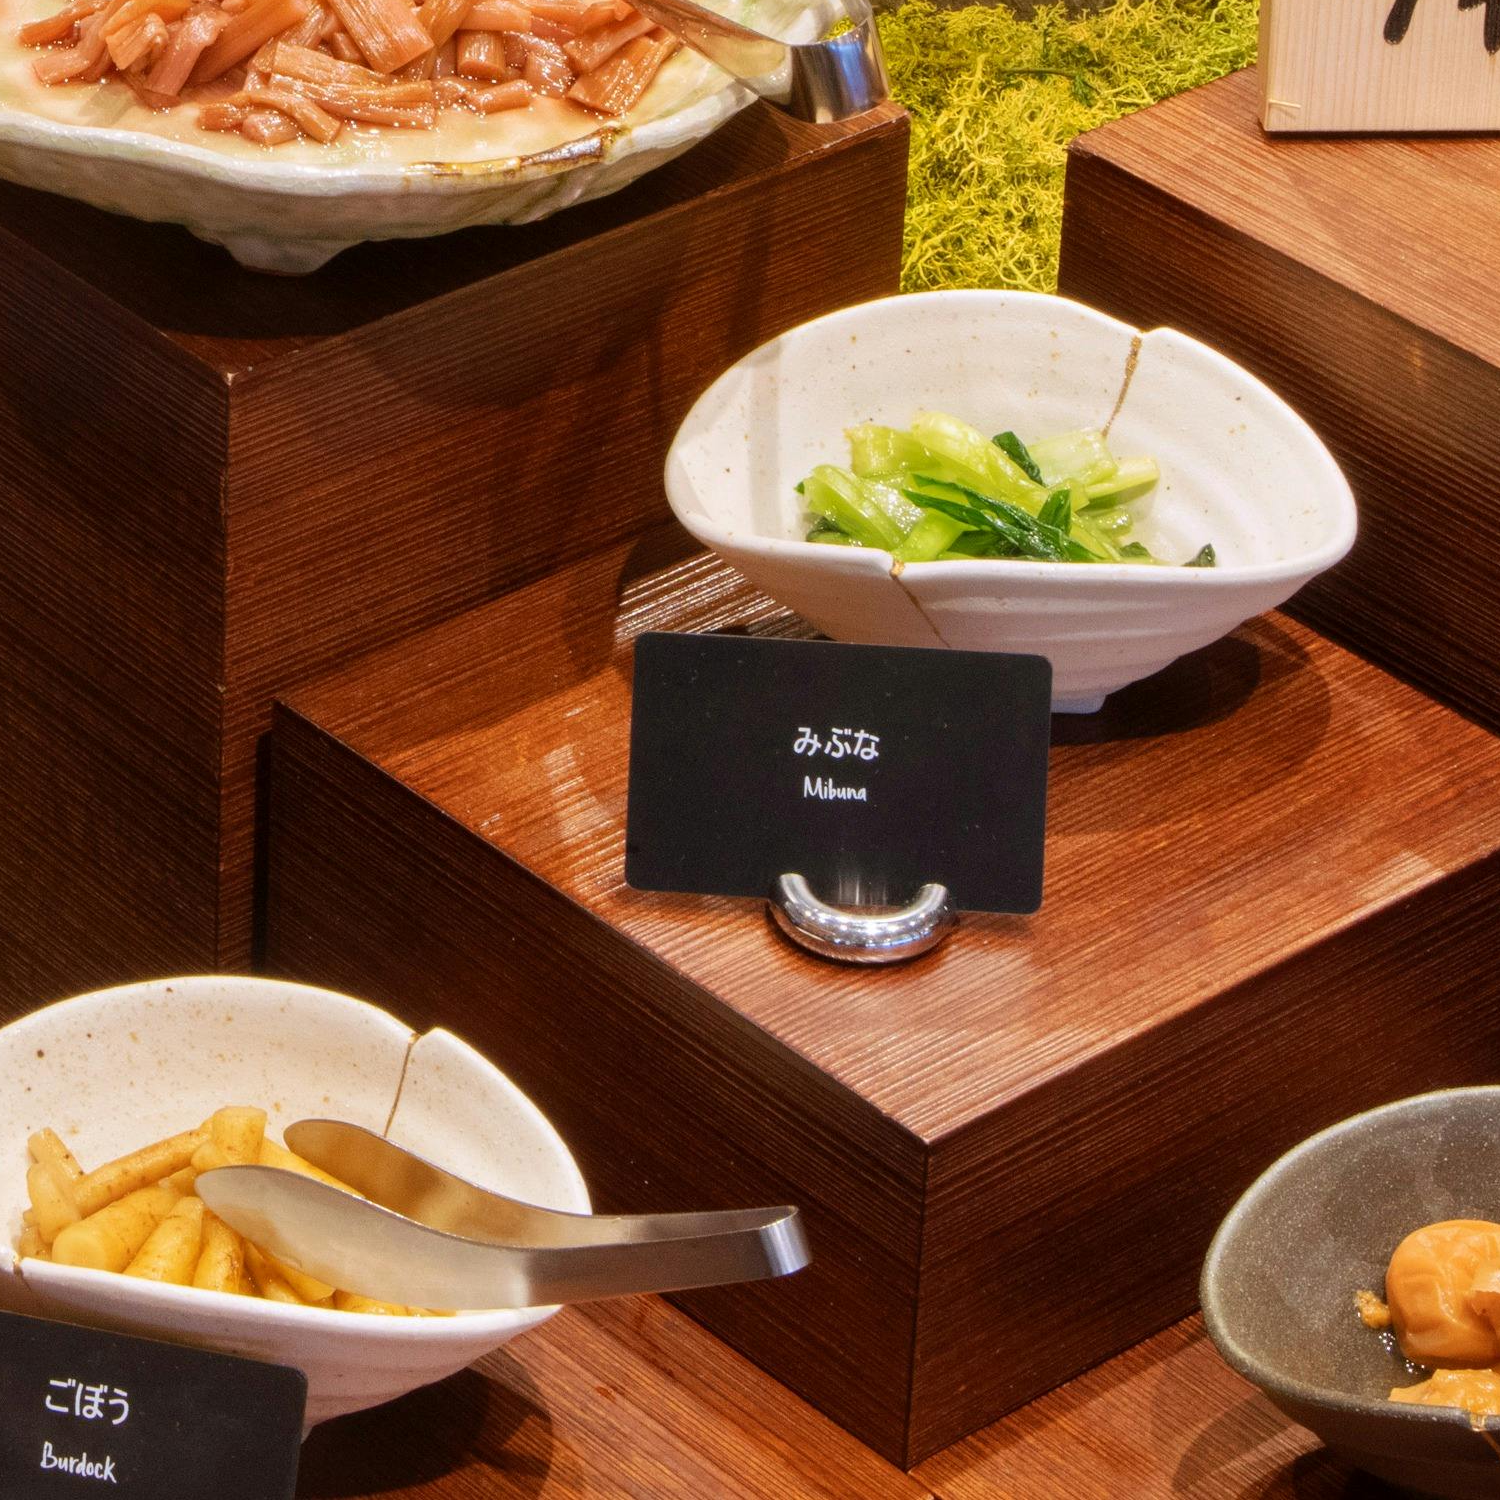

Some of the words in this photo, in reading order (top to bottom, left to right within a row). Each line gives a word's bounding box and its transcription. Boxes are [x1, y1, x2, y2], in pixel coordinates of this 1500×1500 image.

[794, 727, 879, 760] みぶな
[804, 776, 866, 801] Mibuna
[46, 1378, 129, 1425] ごぼう
[40, 1441, 116, 1483] Burdock
